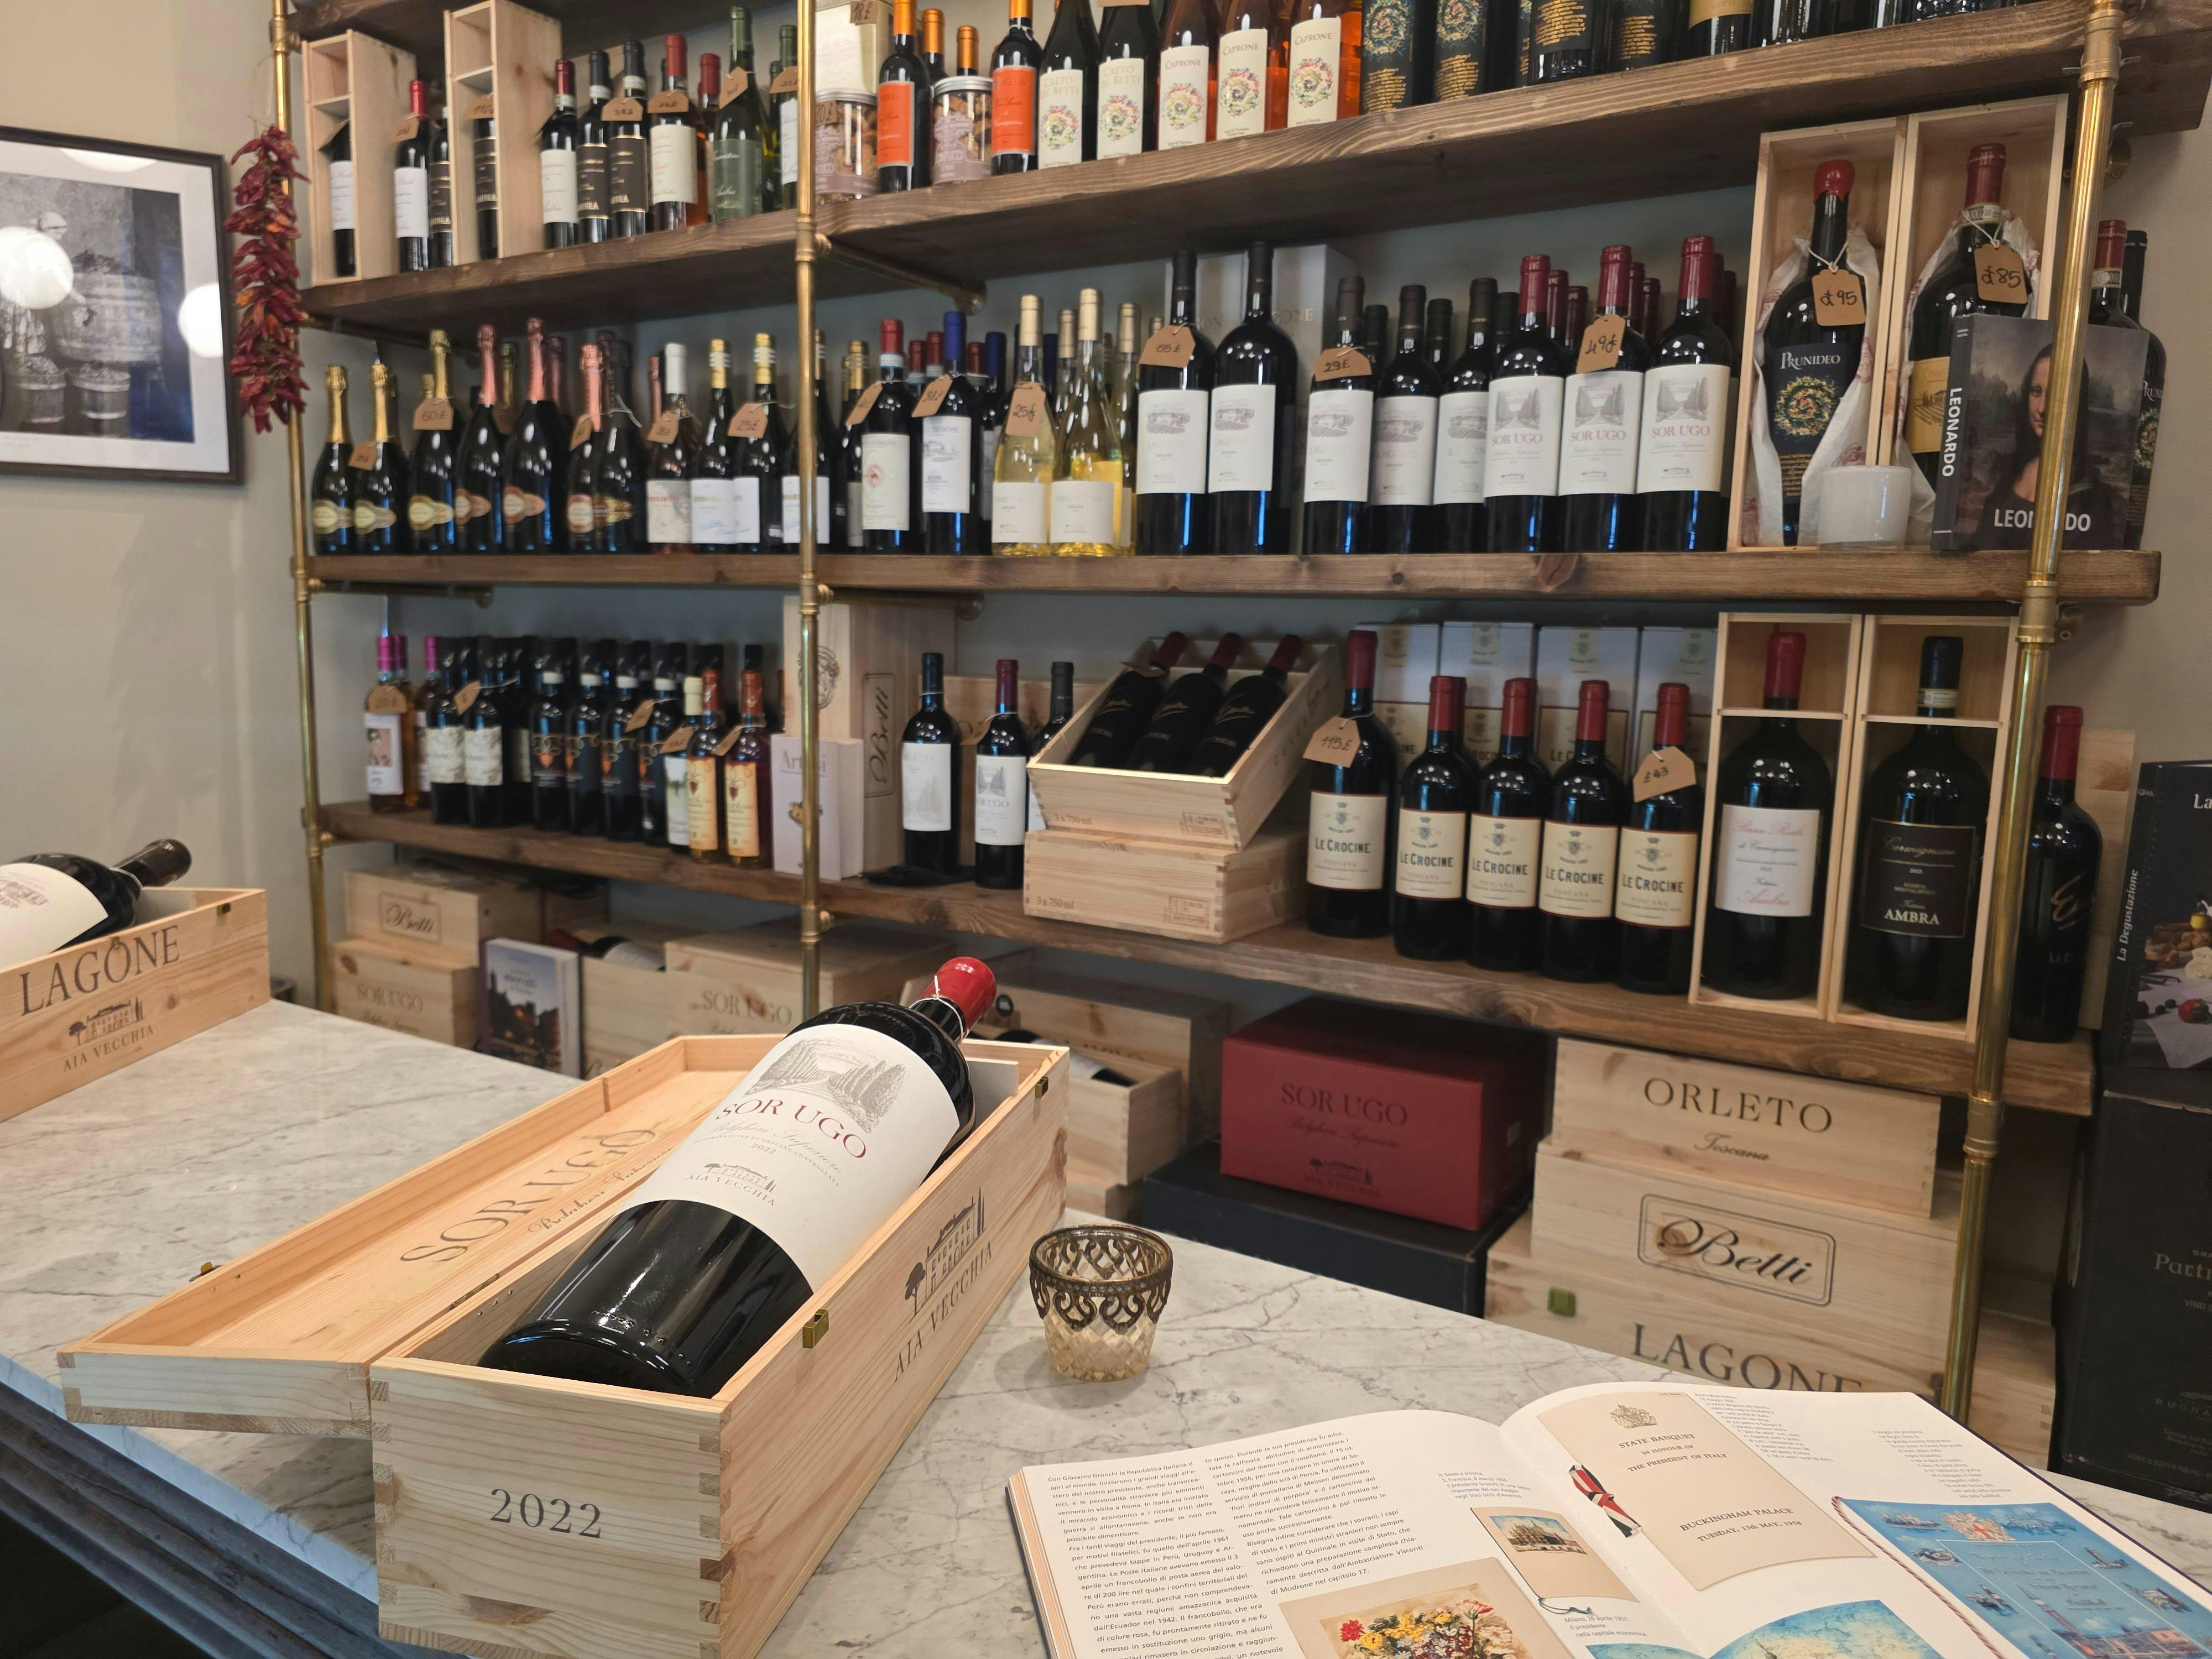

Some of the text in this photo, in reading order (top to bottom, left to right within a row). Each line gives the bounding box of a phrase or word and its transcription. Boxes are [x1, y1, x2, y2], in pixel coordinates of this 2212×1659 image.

[1295, 32, 1332, 45] CAPRONE
[1223, 43, 1259, 56] CAPRONE
[1165, 59, 1202, 70] CAPRONE
[1981, 265, 2022, 288] £85
[1585, 335, 1616, 354] 49£
[1323, 359, 1350, 373] 29£
[1781, 352, 1840, 370] PRUNIDEO
[1491, 432, 1543, 446] SOR UGO
[1570, 429, 1626, 443] SOR UGO
[1651, 425, 1710, 439] SOR UGO
[1942, 388, 1963, 477] LEONARDO
[1994, 509, 2091, 532] LEODO
[1321, 737, 1353, 751] 115£
[2194, 794, 2212, 810] La
[1315, 838, 1370, 854] LE CROCINE
[1400, 852, 1454, 868] LE CROCINE
[1472, 858, 1528, 876] LE CROCINE
[1545, 868, 1604, 885] LE CROCINE
[1623, 873, 1684, 894] LE CROCINE
[1048, 898, 1063, 908] 750
[385, 902, 435, 933] Betti
[1884, 907, 1940, 926] AMBRA
[2117, 869, 2138, 962] La Degustazione
[19, 925, 180, 1016] LAGONE
[703, 989, 740, 1014] SOR
[62, 1024, 154, 1072] AIA VECCHIA
[1281, 1083, 1407, 1126] SOR UGO
[1644, 1076, 1832, 1133] ORLETO
[716, 1098, 867, 1159] SOR UGO
[752, 1143, 776, 1155] 2022
[774, 1128, 841, 1172] Superiore
[1694, 1131, 1771, 1162] Toscana
[760, 1136, 791, 1151] ORIGINE
[794, 1151, 840, 1188] CONTROLLATA
[400, 1196, 552, 1262] SOR
[523, 1129, 655, 1187] UGO
[717, 1177, 775, 1207] VECCHIA
[1658, 1218, 1813, 1287] Betti
[894, 1240, 993, 1383] AIA VECCHIA
[1632, 1322, 1863, 1392] LAGON
[1619, 1433, 1695, 1448] STATE BANQUET
[1651, 1446, 1683, 1454] HONOUR
[1627, 1463, 1646, 1472] THE
[1646, 1455, 1689, 1467] PRESIDENT
[490, 1488, 602, 1539] 2022
[1679, 1510, 1753, 1531] BUCKINGHAM
[1177, 1540, 1211, 1549] dell'aprile
[1697, 1527, 1740, 1542] TUESDAY,
[1261, 1564, 1298, 1575] richiedono
[1316, 1549, 1362, 1564] preparazione
[1364, 1541, 1399, 1552] complessa
[1266, 1545, 1423, 1585] ramente descritta dall'Ambasciatore Visconti
[1179, 1600, 1222, 1610] amazzonica
[1225, 1594, 1258, 1603] acquisita
[1094, 1621, 1140, 1631] dall'Ecuador
[1187, 1609, 1232, 1620] francobollo,
[1162, 1624, 1212, 1636] prontamente
[1214, 1619, 1240, 1627] ritirato
